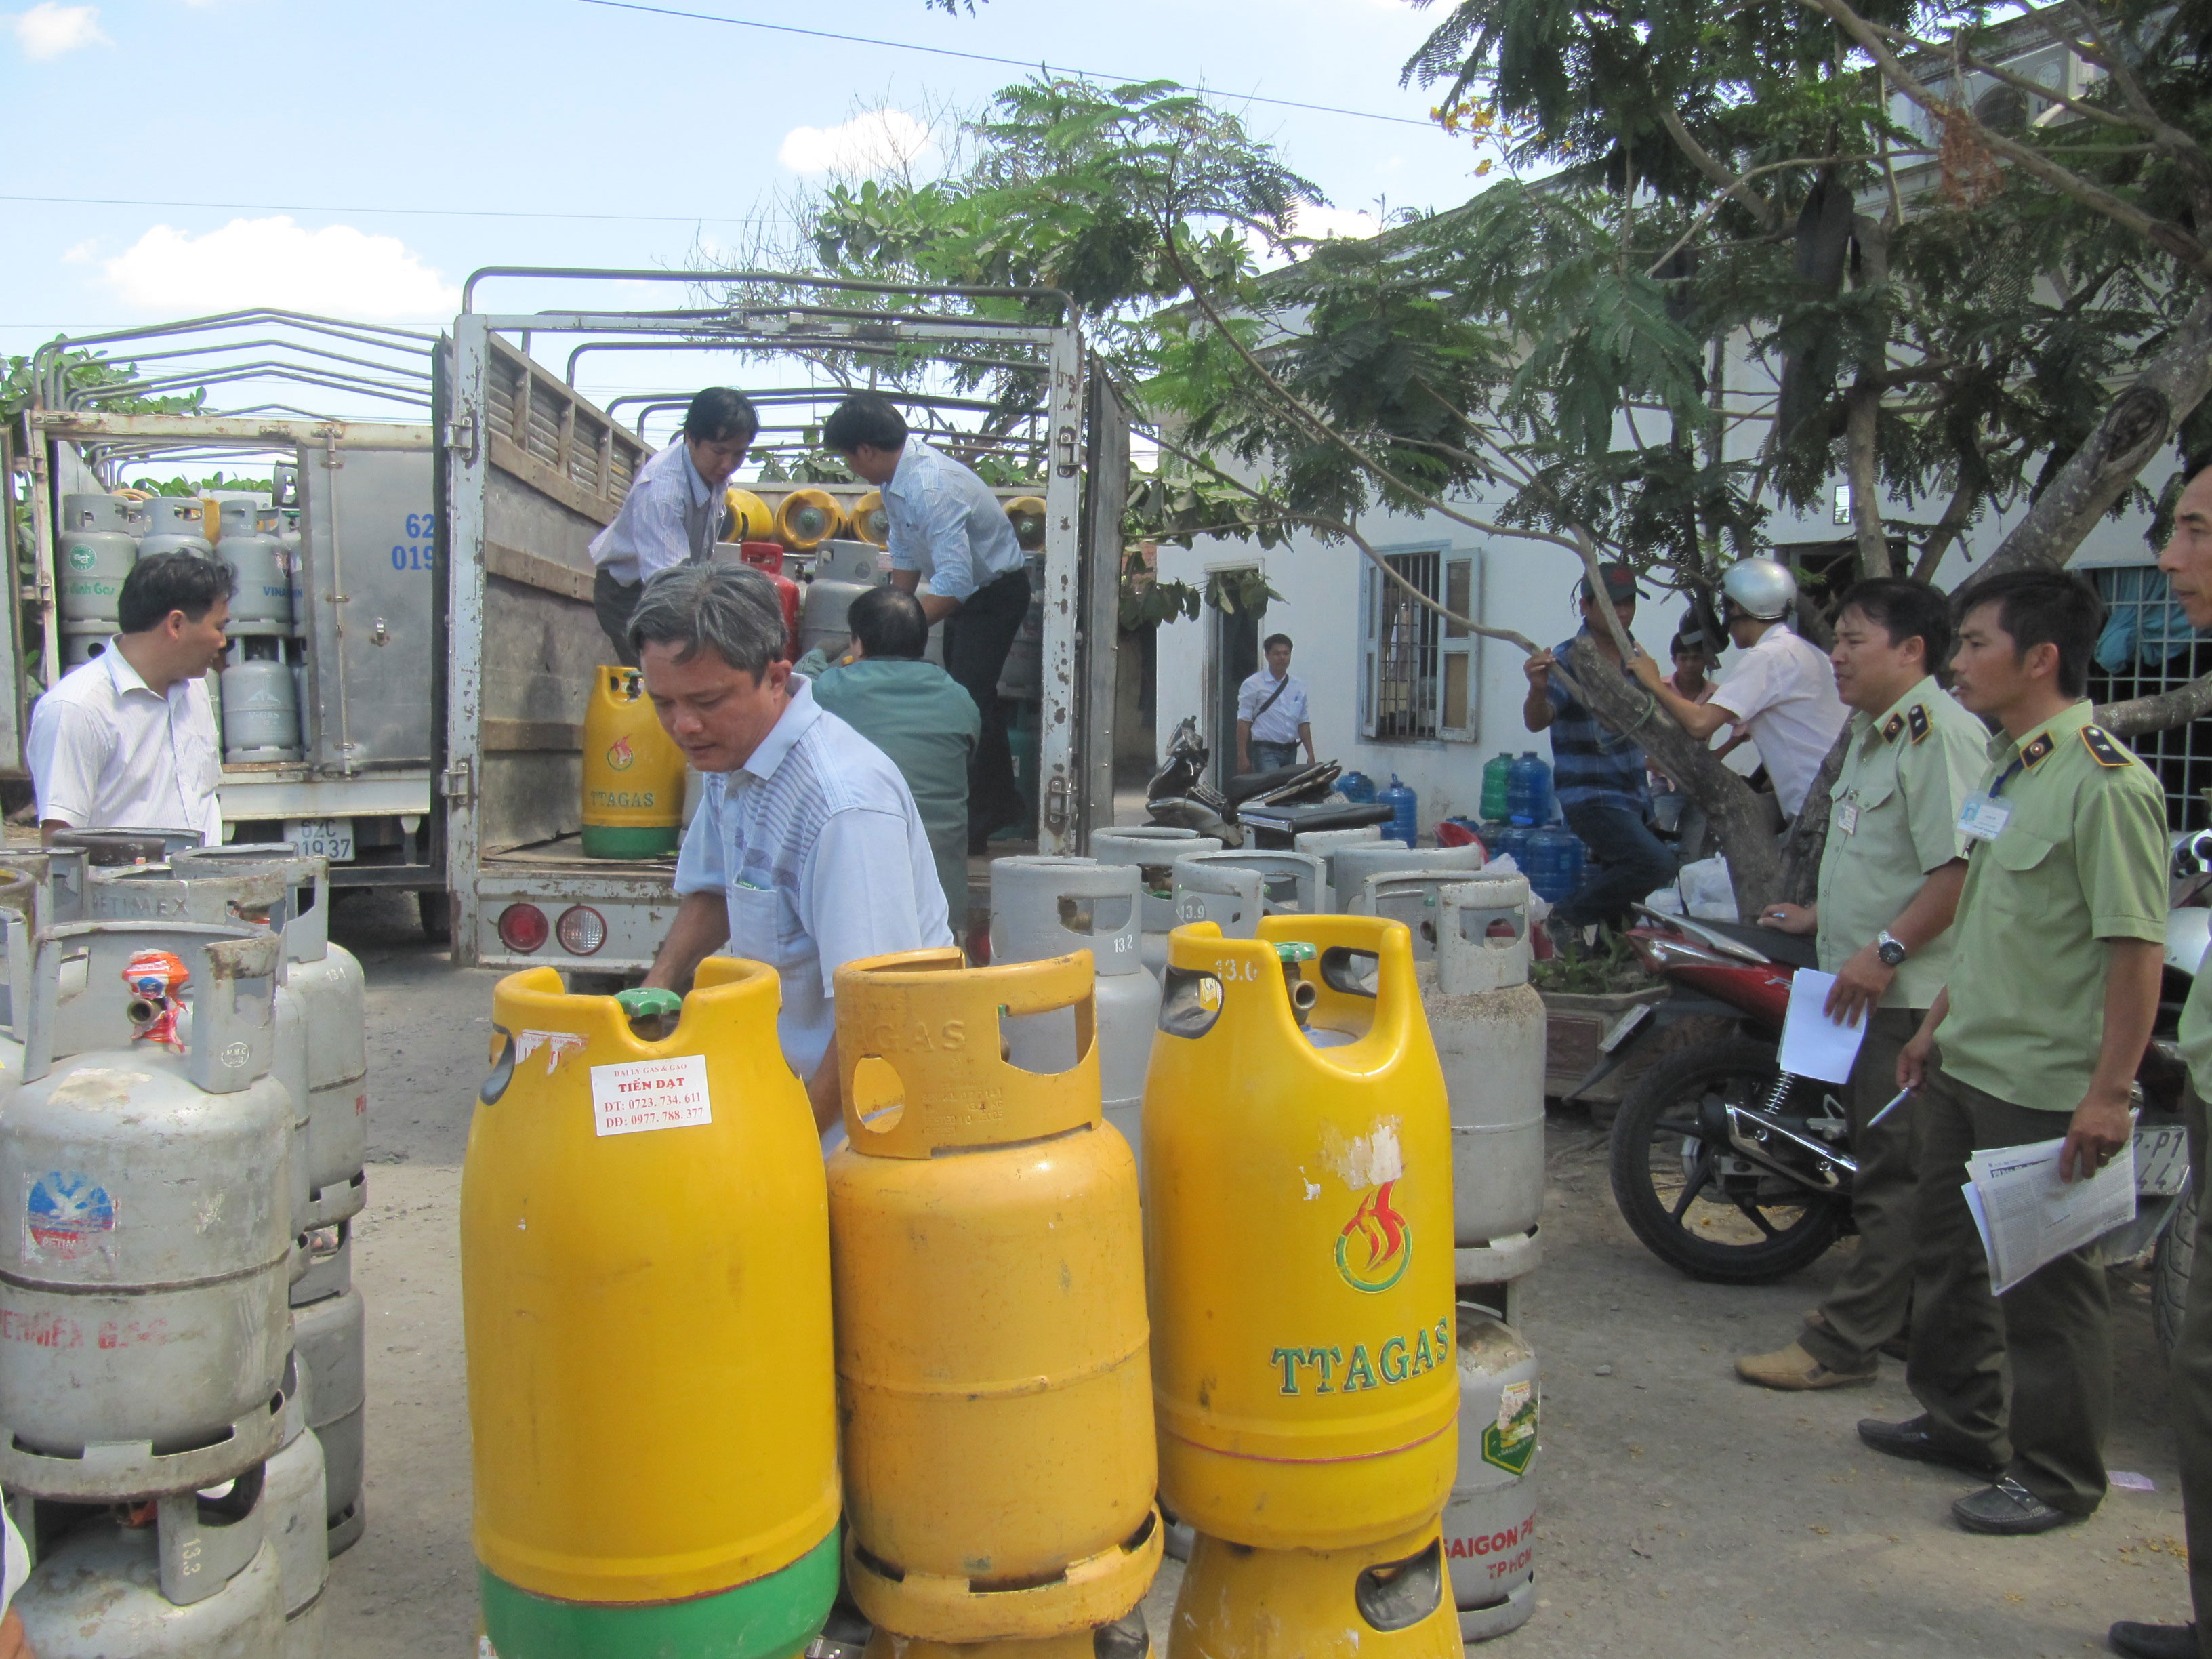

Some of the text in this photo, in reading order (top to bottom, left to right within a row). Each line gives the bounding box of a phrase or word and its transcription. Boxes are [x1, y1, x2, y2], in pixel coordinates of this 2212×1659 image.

[406, 513, 434, 539] 62
[590, 790, 654, 807] TTAGAS
[301, 818, 336, 838] 62C
[1181, 905, 1206, 919] 13.9
[1113, 934, 1133, 953] 13.2
[618, 1078, 685, 1093] TIẾN ĐẠT
[604, 1101, 625, 1113] ĐT:
[684, 1092, 701, 1103] 611
[606, 1117, 627, 1128] DĐ:
[687, 1107, 703, 1119] 377
[1269, 1316, 1450, 1396] TTAGAS
